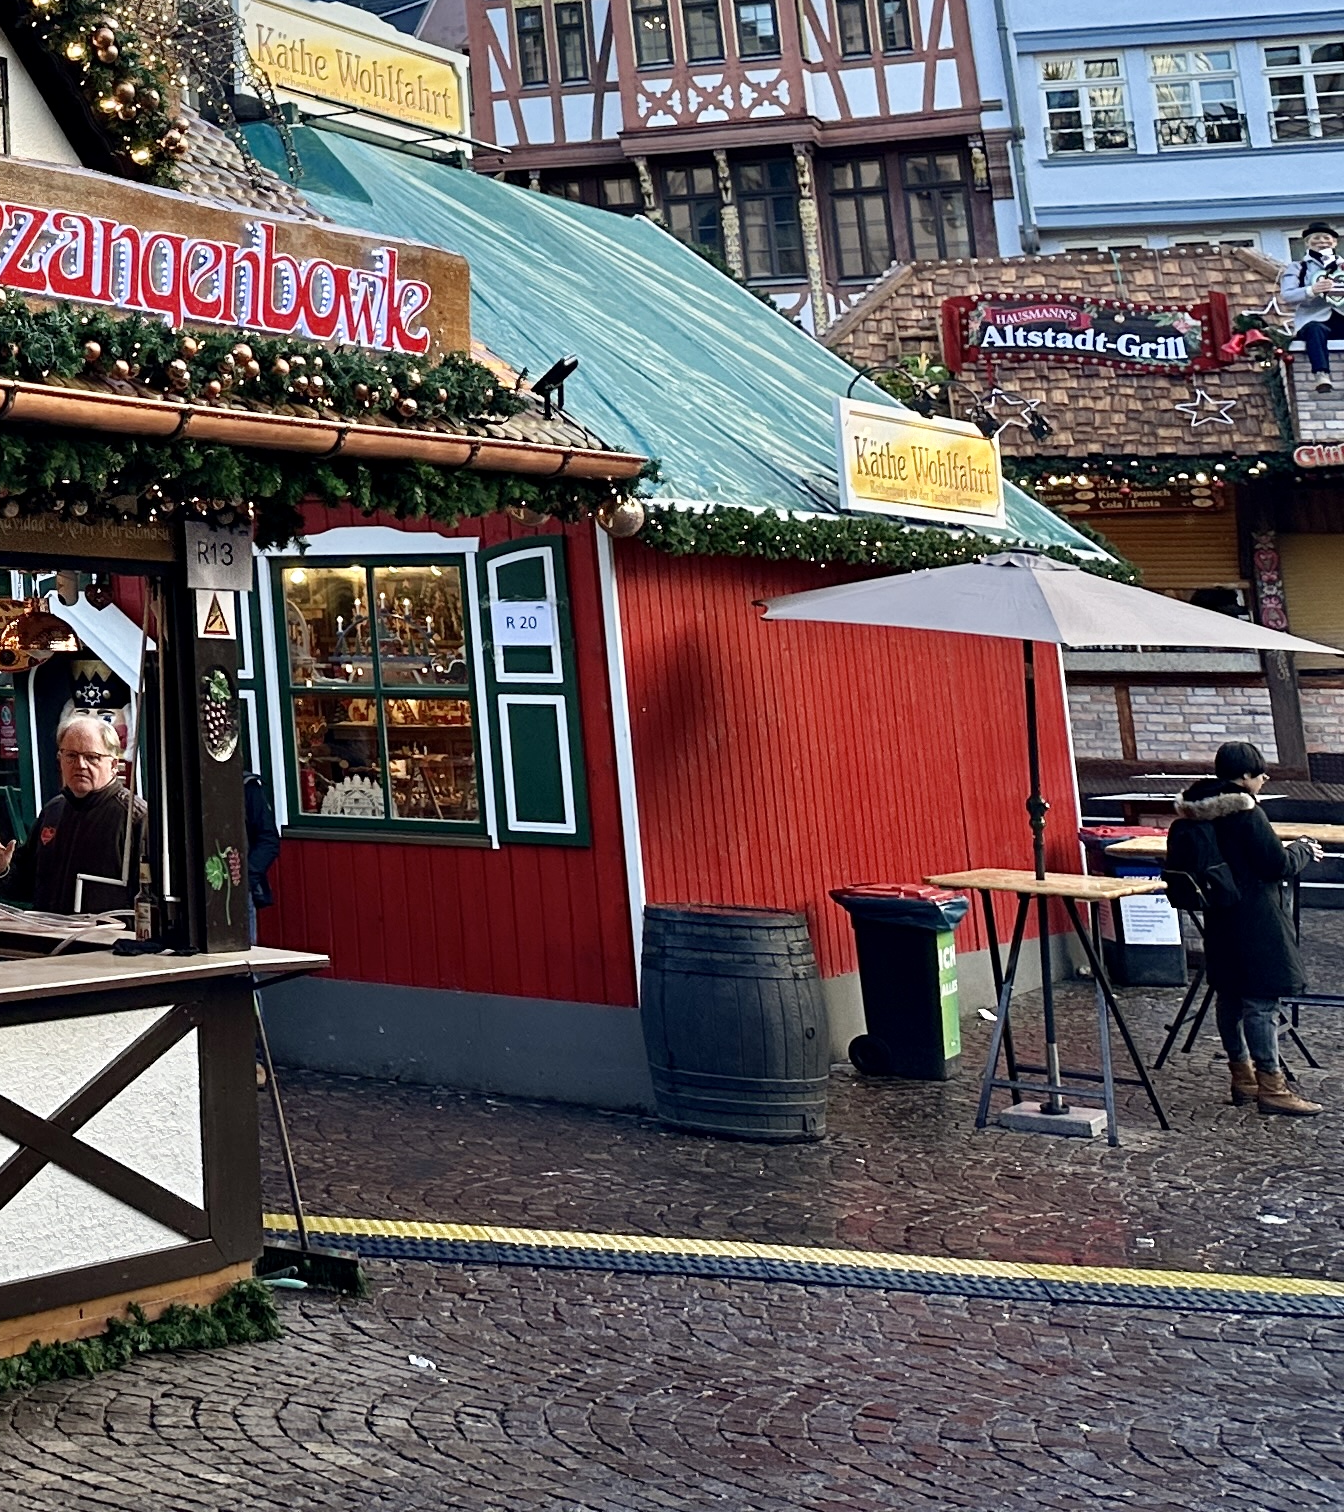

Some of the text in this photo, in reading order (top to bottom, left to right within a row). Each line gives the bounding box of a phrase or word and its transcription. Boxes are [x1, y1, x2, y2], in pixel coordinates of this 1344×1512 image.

[255, 23, 453, 121] Käthe Wohlfahrt
[980, 324, 1189, 360] Altstadt-Grill
[854, 435, 993, 495] Käthe Wohlfahrt
[1099, 500, 1123, 509] Cola
[197, 541, 234, 567] R13
[506, 616, 537, 629] R 20
